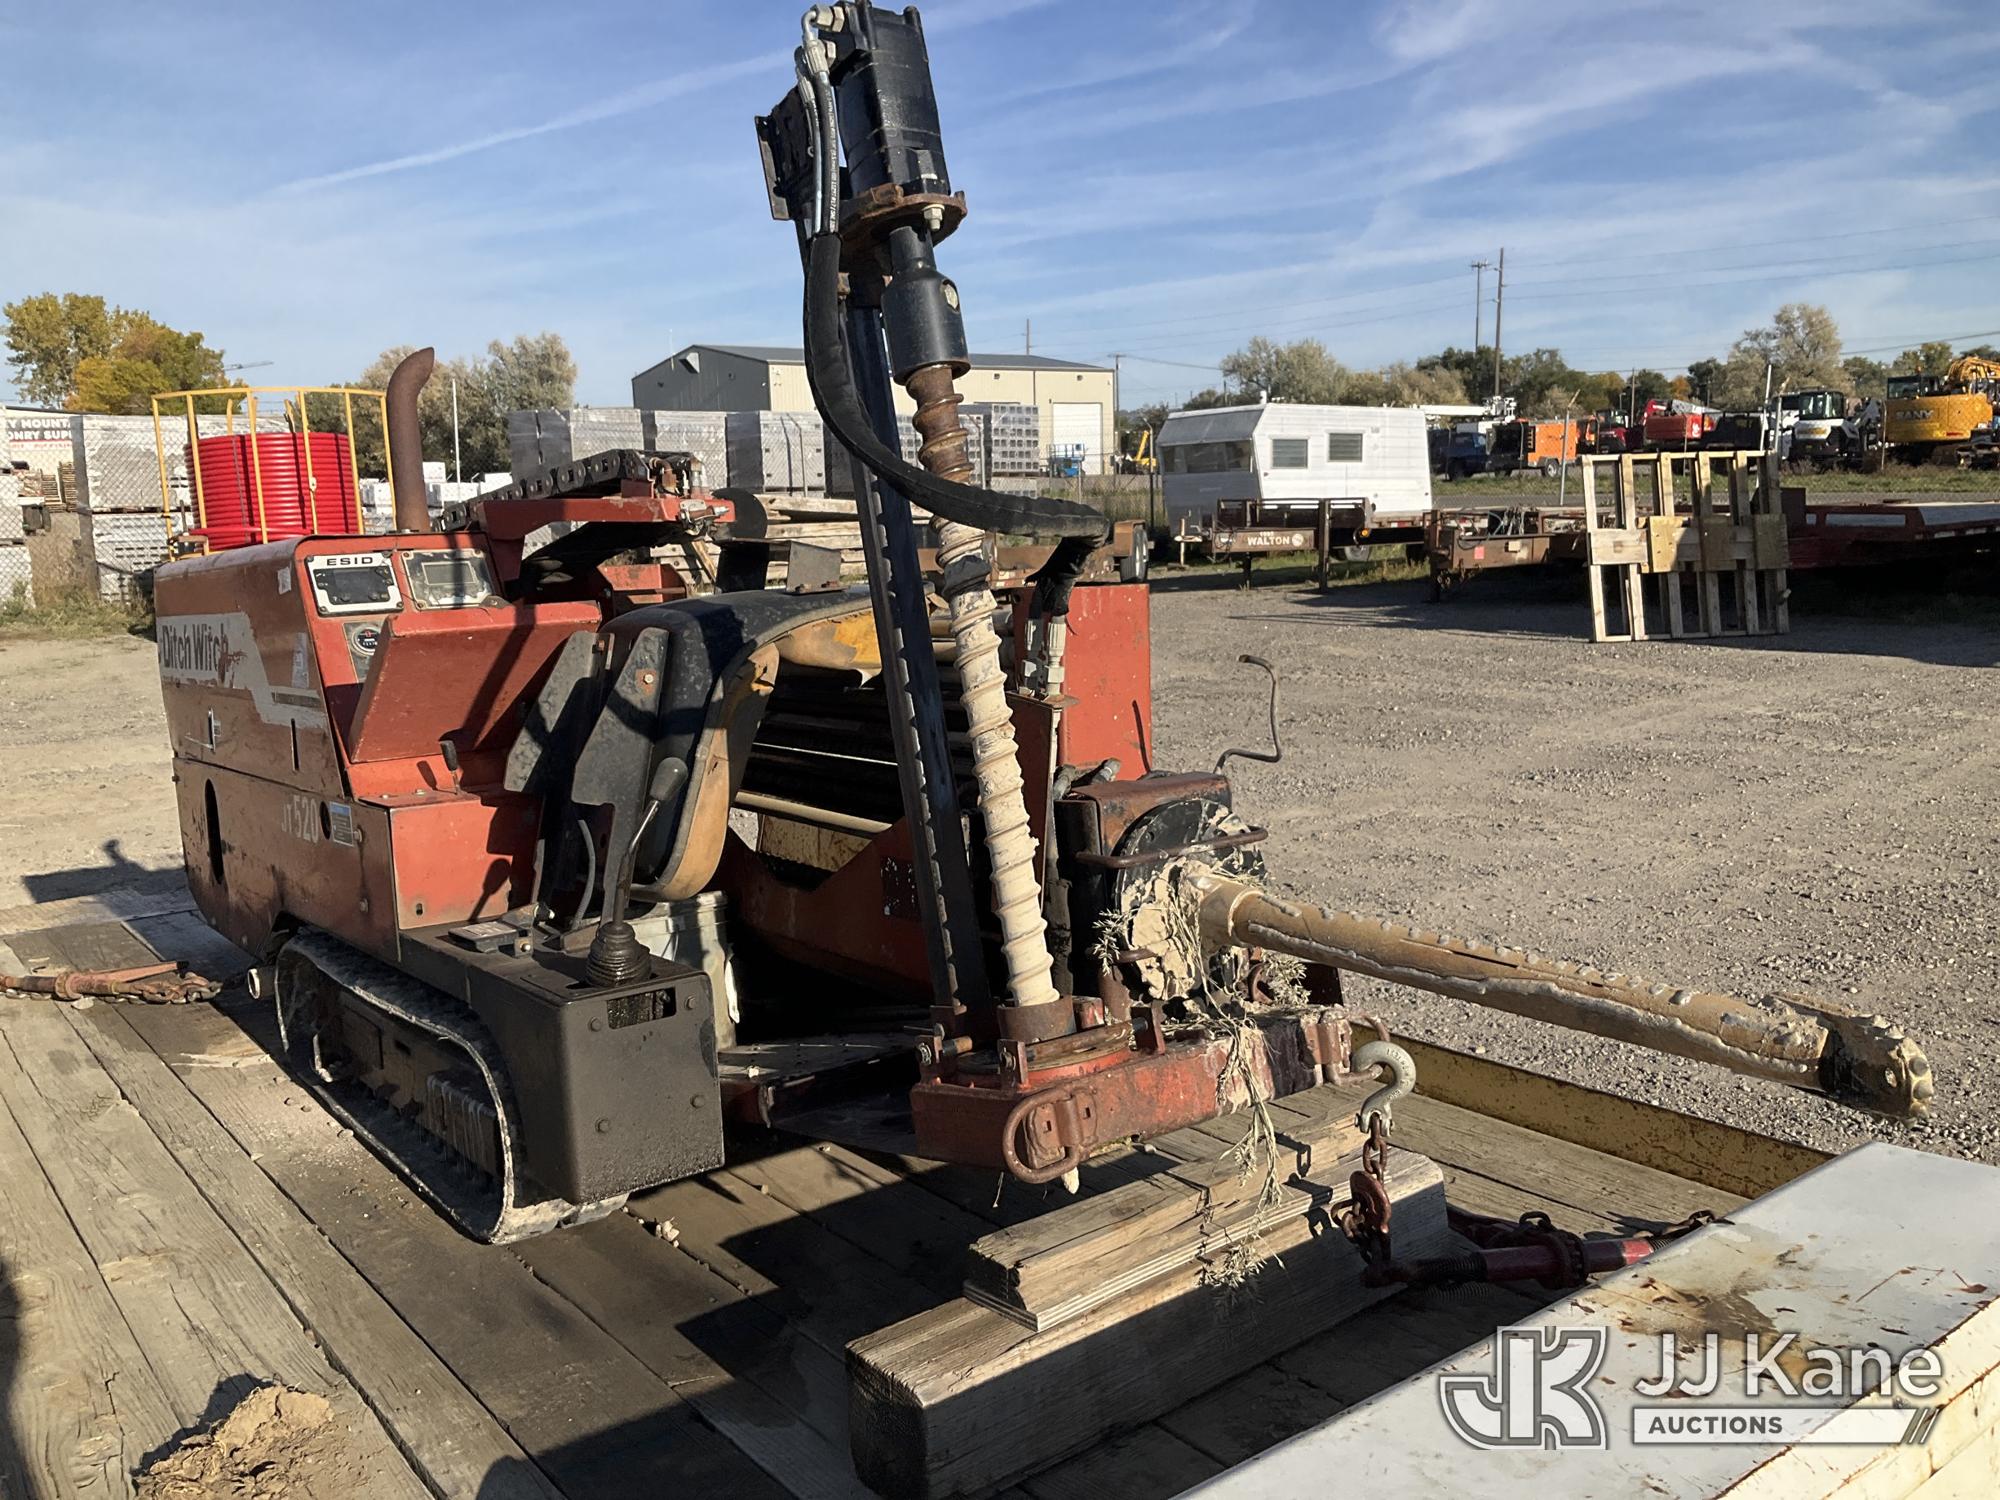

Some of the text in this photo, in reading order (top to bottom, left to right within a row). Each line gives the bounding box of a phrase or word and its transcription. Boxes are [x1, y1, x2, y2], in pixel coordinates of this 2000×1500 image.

[1247, 536, 1290, 546] WALTON
[326, 556, 373, 567] ESID
[162, 624, 191, 670] Ditch
